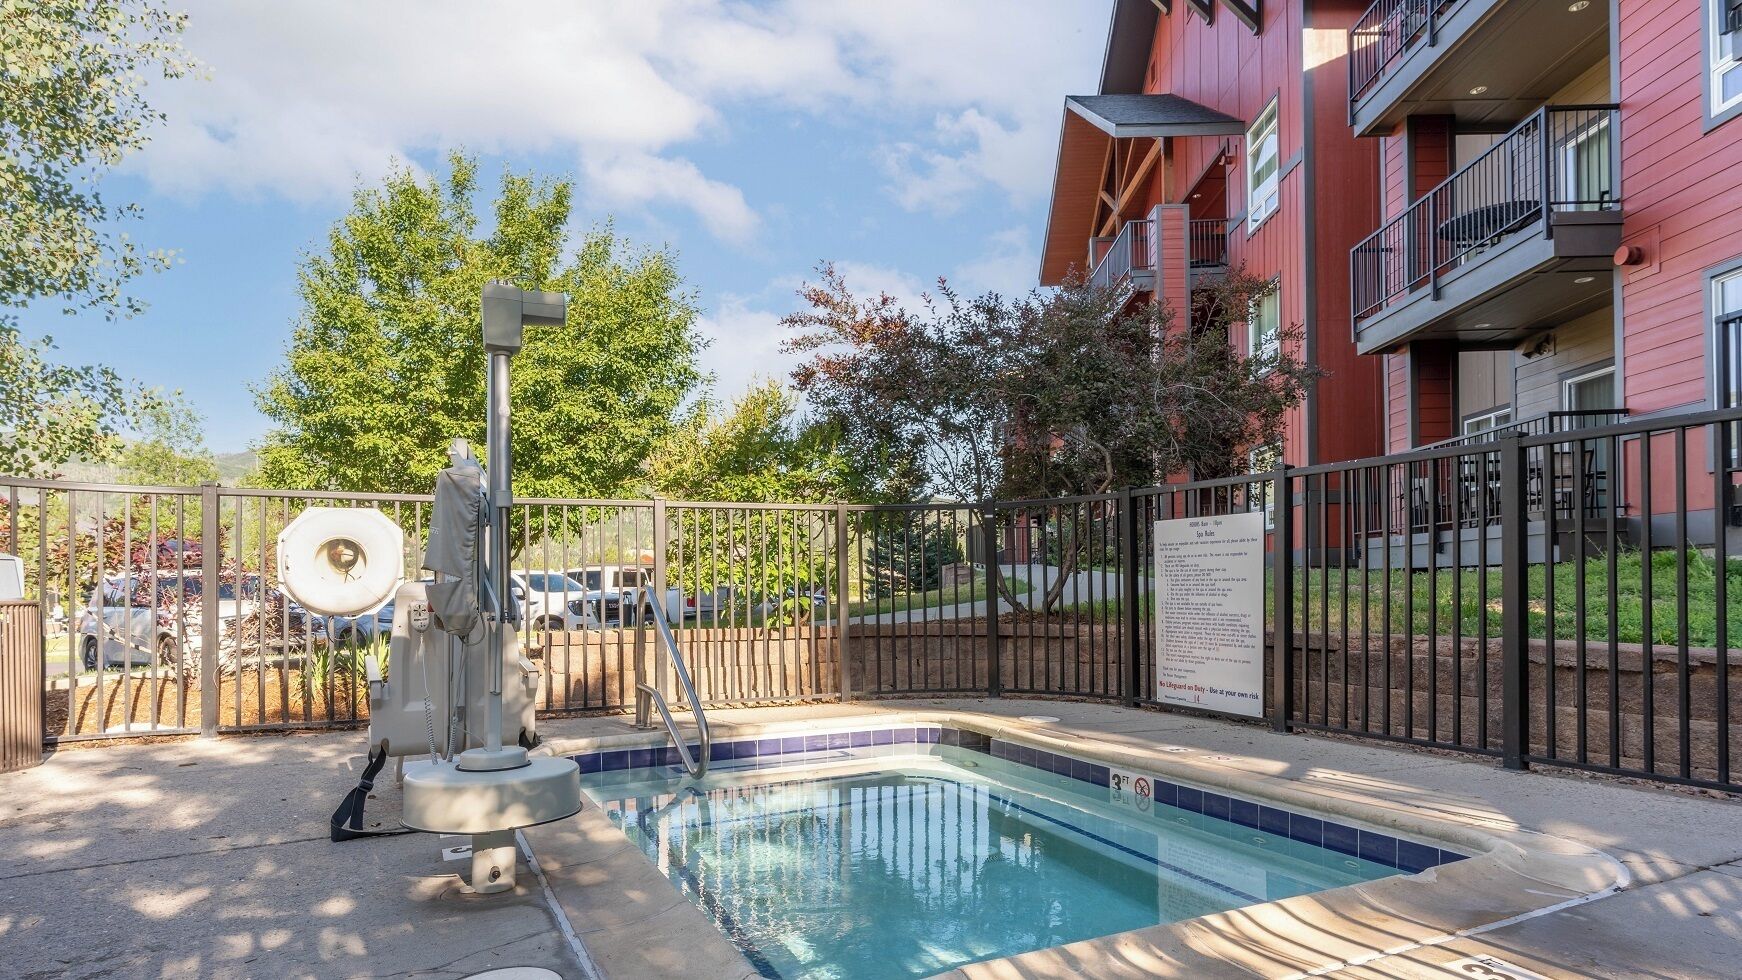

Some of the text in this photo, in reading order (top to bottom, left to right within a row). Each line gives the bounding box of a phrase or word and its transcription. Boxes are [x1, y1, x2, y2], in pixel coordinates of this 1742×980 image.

[1166, 681, 1187, 692] Lifeguard
[1194, 684, 1205, 694] Duty
[1225, 690, 1237, 699] your
[1249, 692, 1260, 700] risk
[1112, 774, 1129, 790] 3 FT
[1462, 964, 1517, 980] 3
